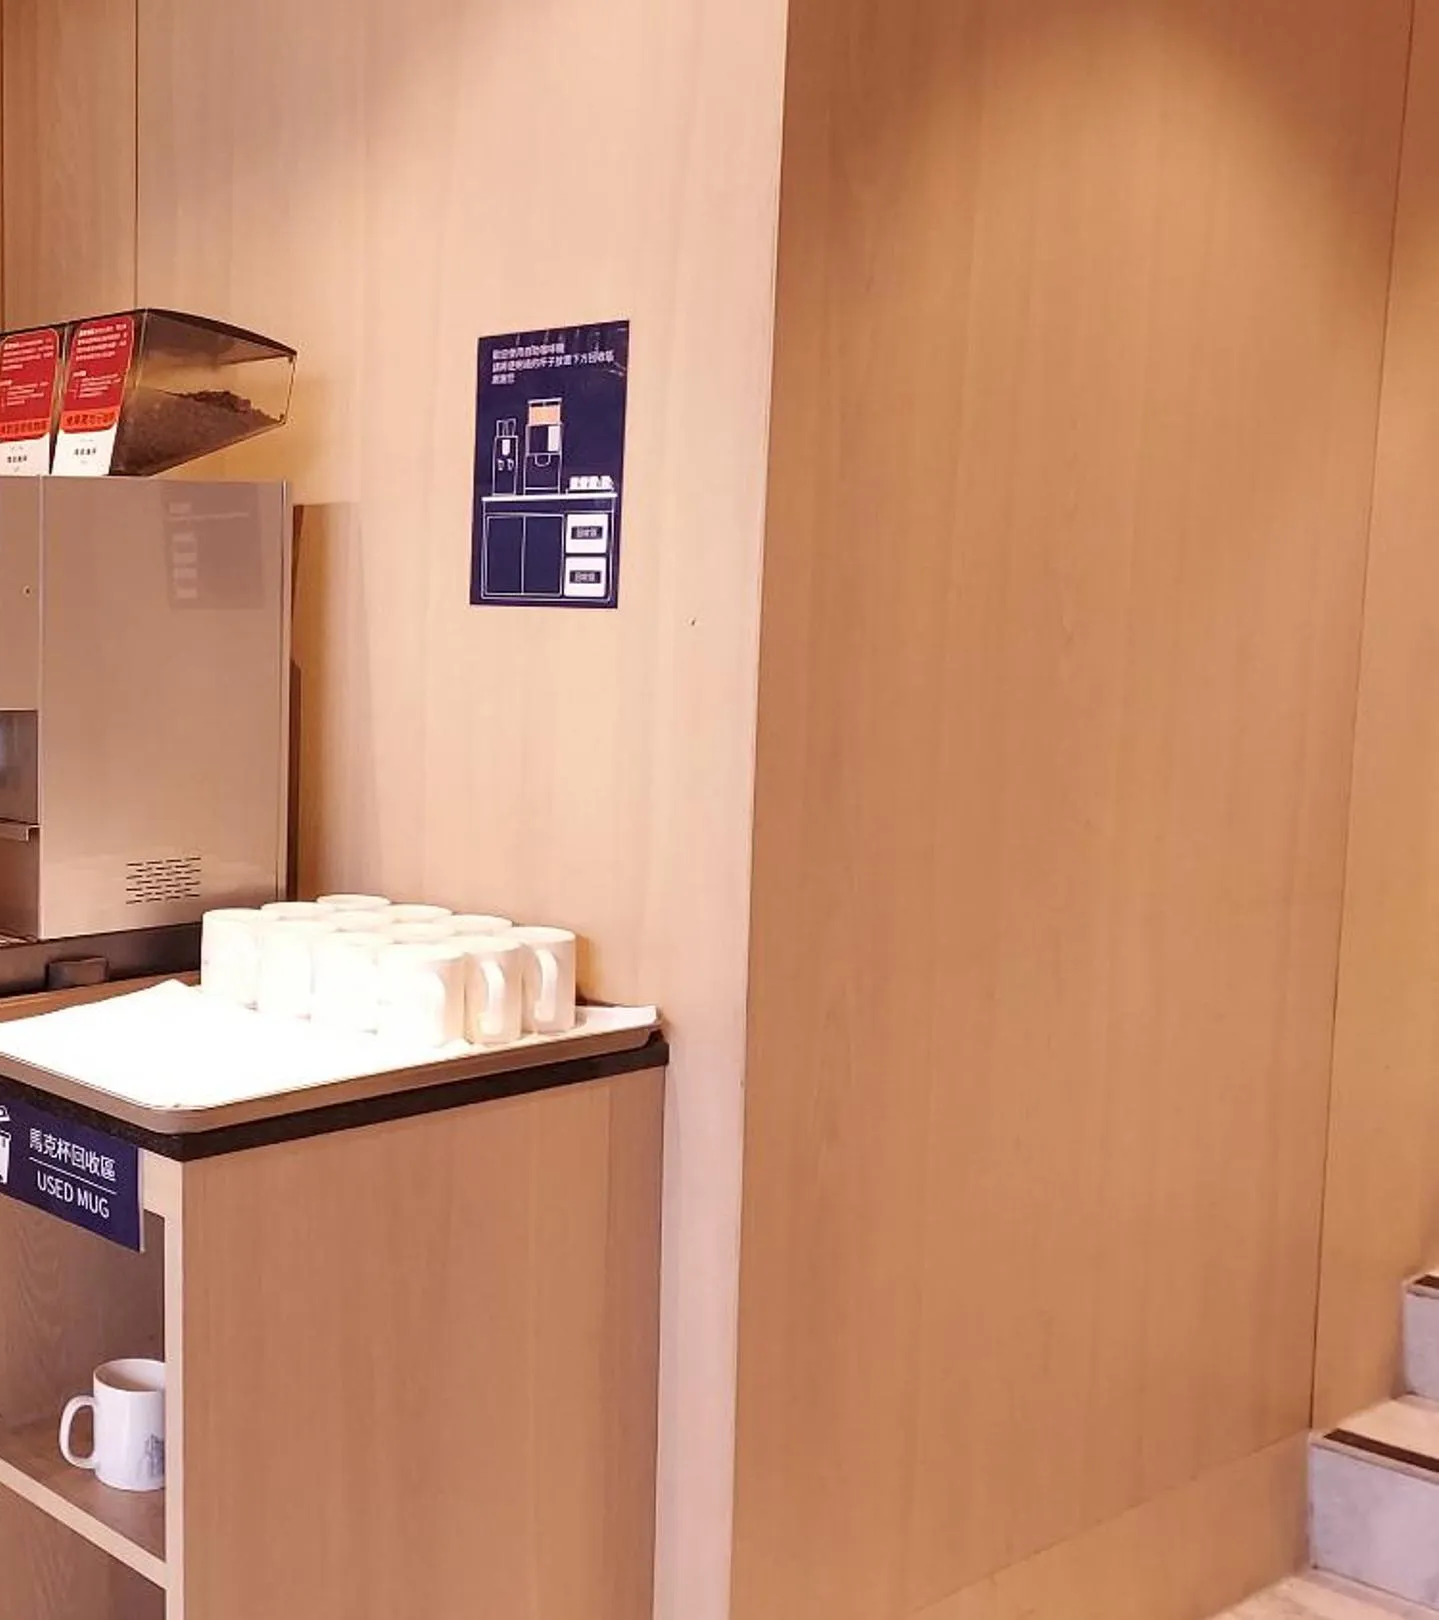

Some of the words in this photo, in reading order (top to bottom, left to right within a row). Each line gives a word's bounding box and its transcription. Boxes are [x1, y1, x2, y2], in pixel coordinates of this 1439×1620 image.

[29, 1127, 117, 1182] 馬克杯回收區
[37, 1170, 74, 1203] USED
[77, 1187, 110, 1219] MUG
